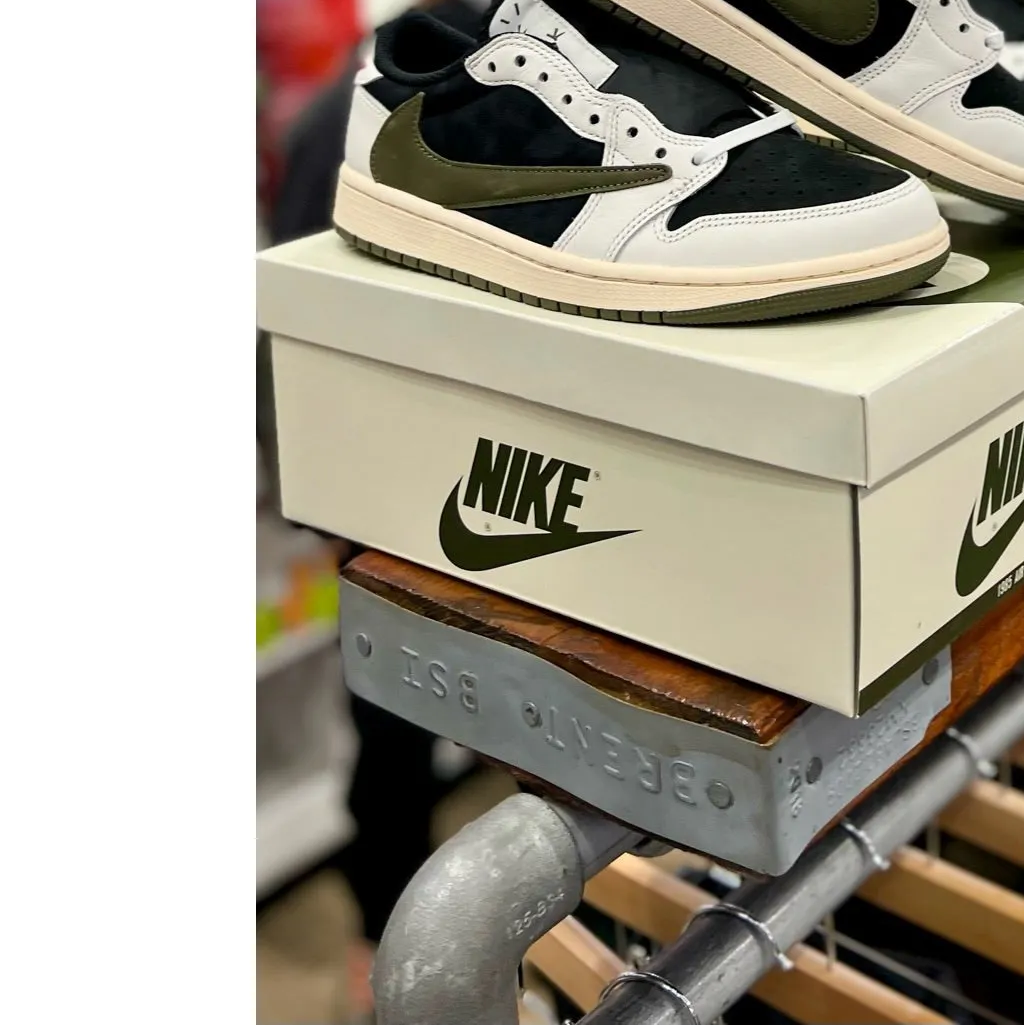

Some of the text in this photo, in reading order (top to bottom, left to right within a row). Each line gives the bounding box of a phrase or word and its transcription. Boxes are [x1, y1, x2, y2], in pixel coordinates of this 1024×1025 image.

[463, 437, 592, 533] NIKE
[400, 645, 480, 714] BSI
[544, 704, 698, 807] BRENT
